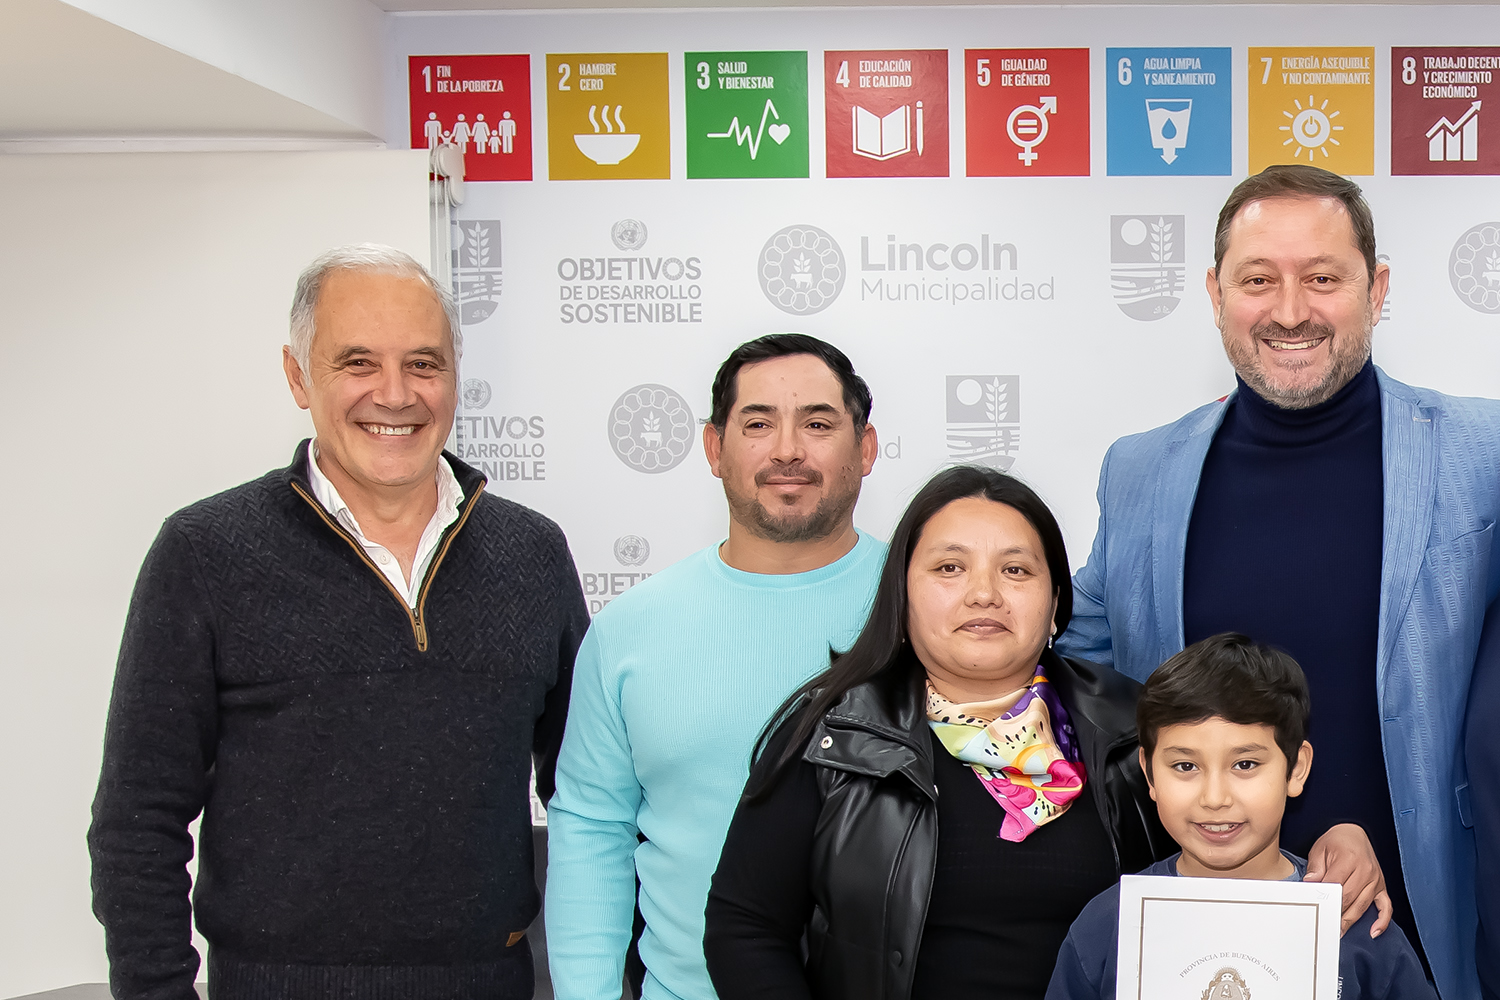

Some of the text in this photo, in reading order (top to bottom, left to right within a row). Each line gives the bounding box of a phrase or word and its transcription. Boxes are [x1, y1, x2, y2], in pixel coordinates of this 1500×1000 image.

[579, 63, 617, 76] HAMBRE
[717, 61, 747, 74] SALUD
[859, 59, 911, 73] EDUCACIÓN
[1001, 59, 1047, 71] IGUALDAD
[1144, 58, 1201, 70] AGUA LIMPIA
[1281, 55, 1370, 70] ENERGÍA ASEQUIBLE
[1423, 57, 1467, 70] TRABAJO
[436, 66, 451, 78] FIN
[558, 64, 571, 91] 2
[697, 62, 710, 89] 3
[836, 60, 850, 88] 4
[977, 59, 991, 86] 5
[1117, 58, 1132, 86] 6
[1260, 58, 1273, 84] 7
[1402, 57, 1416, 84] 8
[1423, 71, 1492, 84] Y CRECIMIENTO
[422, 65, 432, 93] 1
[579, 79, 603, 91] CERO
[718, 77, 774, 89] Y BIENESTAR
[859, 74, 912, 87] DE CALIDAD
[1001, 71, 1050, 86] DE GÉNERO
[1144, 72, 1216, 86] Y SANEAMIENTO
[1282, 72, 1370, 85] Y NO CONTAMINANTE
[437, 80, 504, 93] DE LA POBREZA
[1423, 84, 1478, 98] ECONÓMICO
[860, 234, 1018, 272] Lincoln
[557, 257, 702, 281] OBJETIVOS
[559, 285, 702, 300] DE DESARROLLO
[860, 277, 1055, 305] Municipalidad
[559, 303, 702, 324] SOSTENIBLE
[1179, 954, 1218, 979] PROVINCIA
[1231, 952, 1261, 966] BUENOS
[1261, 963, 1280, 982] AIRES
